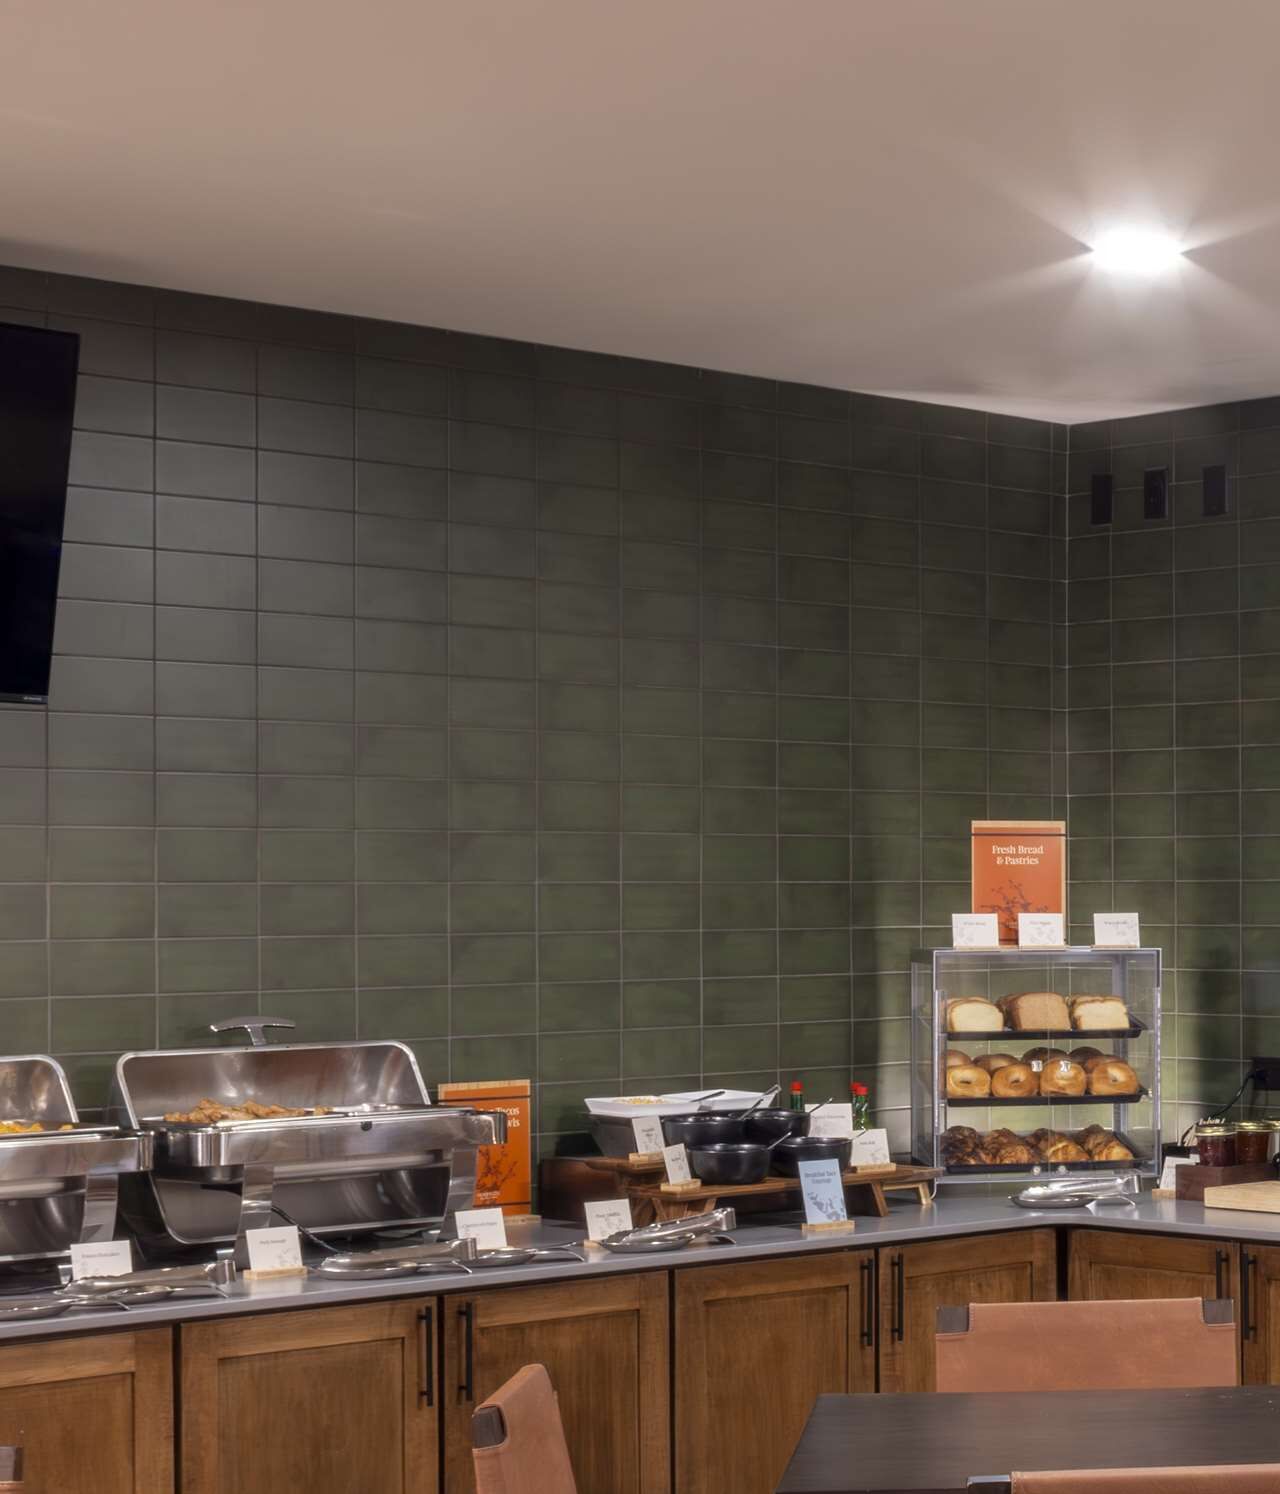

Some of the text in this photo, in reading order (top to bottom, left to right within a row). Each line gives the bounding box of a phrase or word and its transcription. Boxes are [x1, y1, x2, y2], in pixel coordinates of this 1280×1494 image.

[992, 845, 1044, 854] Fresh Bread
[996, 856, 1039, 865] & Pastries
